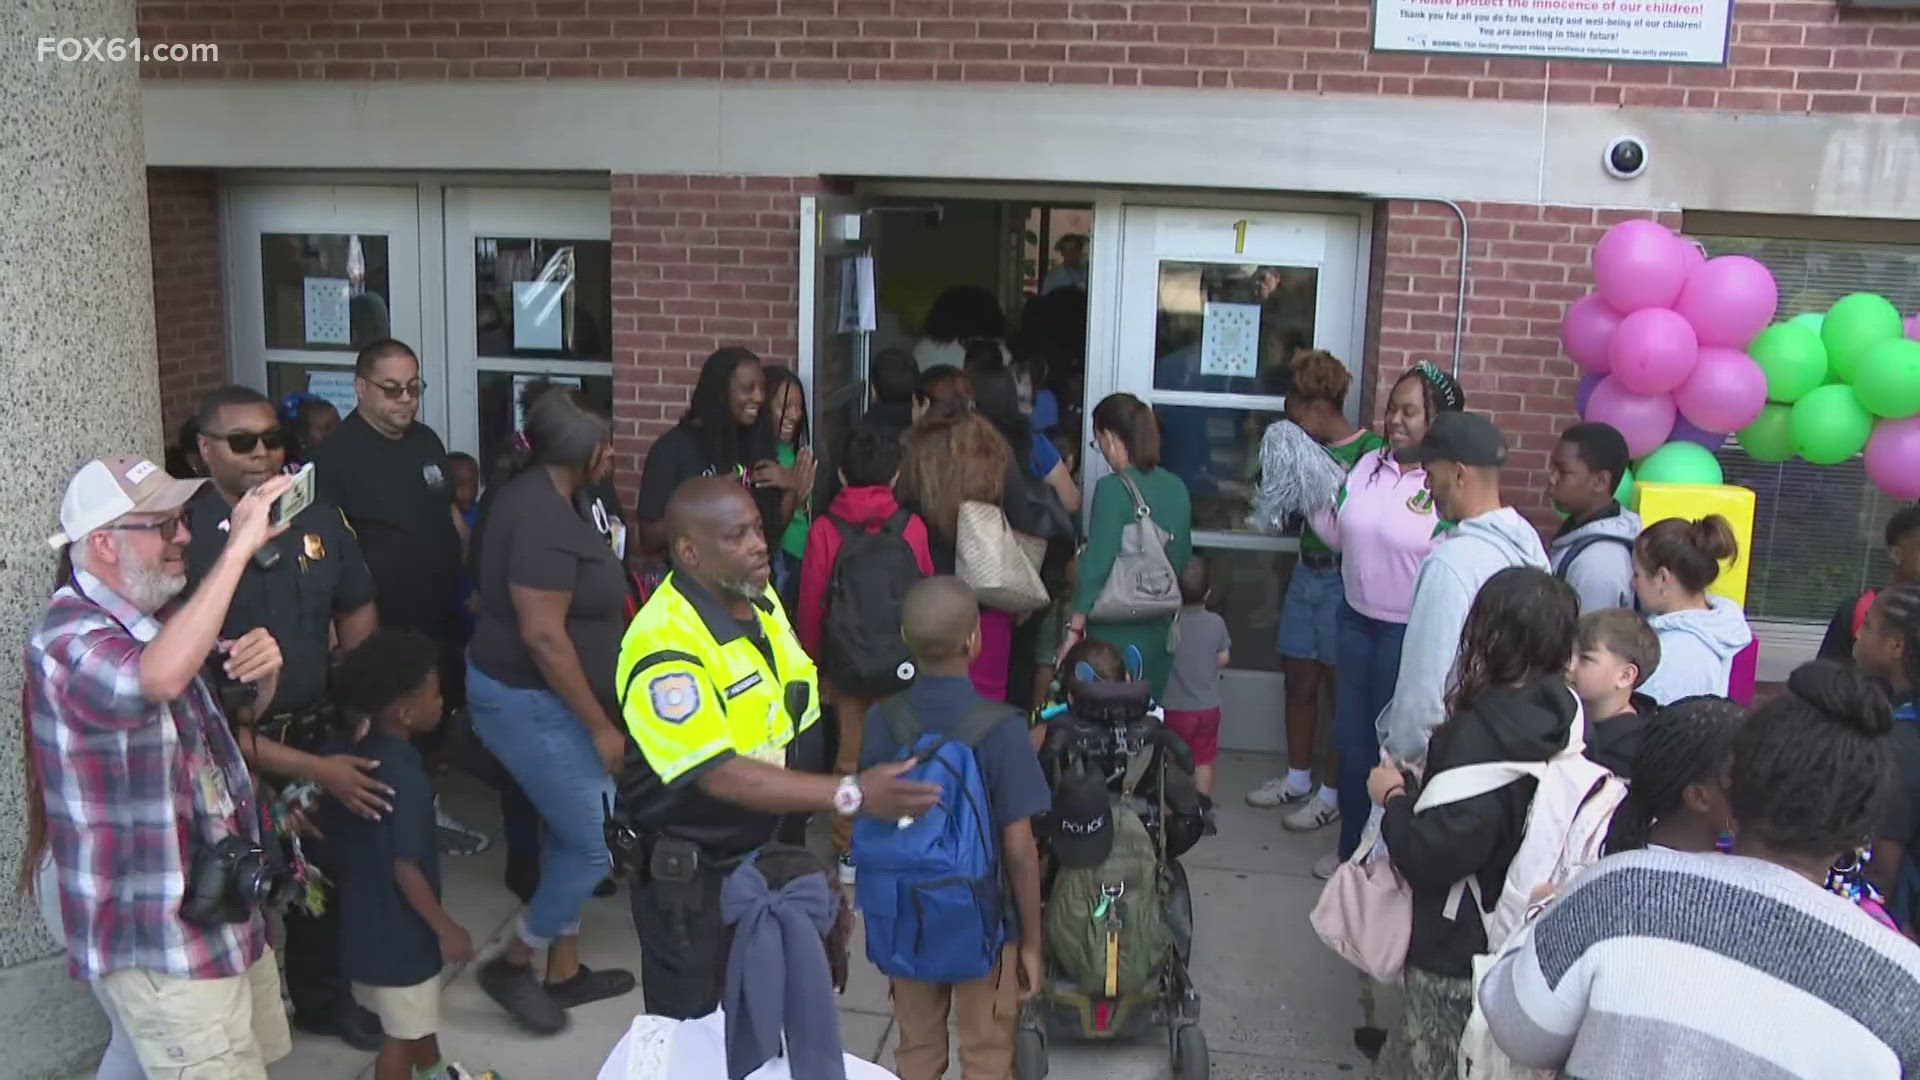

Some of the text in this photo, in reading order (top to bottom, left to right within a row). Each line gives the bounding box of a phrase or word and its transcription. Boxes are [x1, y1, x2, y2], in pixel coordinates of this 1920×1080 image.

[1508, 0, 1528, 8] the
[1532, 0, 1599, 10] innocence
[1602, 1, 1616, 11] of
[1619, 4, 1641, 12] our
[1645, 3, 1704, 15] children!
[1399, 9, 1702, 30] Thank you for all you do for the safety and well-being of our children!
[1479, 27, 1495, 36] You
[1513, 29, 1553, 40] investing
[1555, 30, 1564, 38] in
[1566, 30, 1586, 39] their
[1589, 31, 1619, 40] future!
[1233, 219, 1247, 254] 1
[1062, 815, 1104, 834] POLICE
